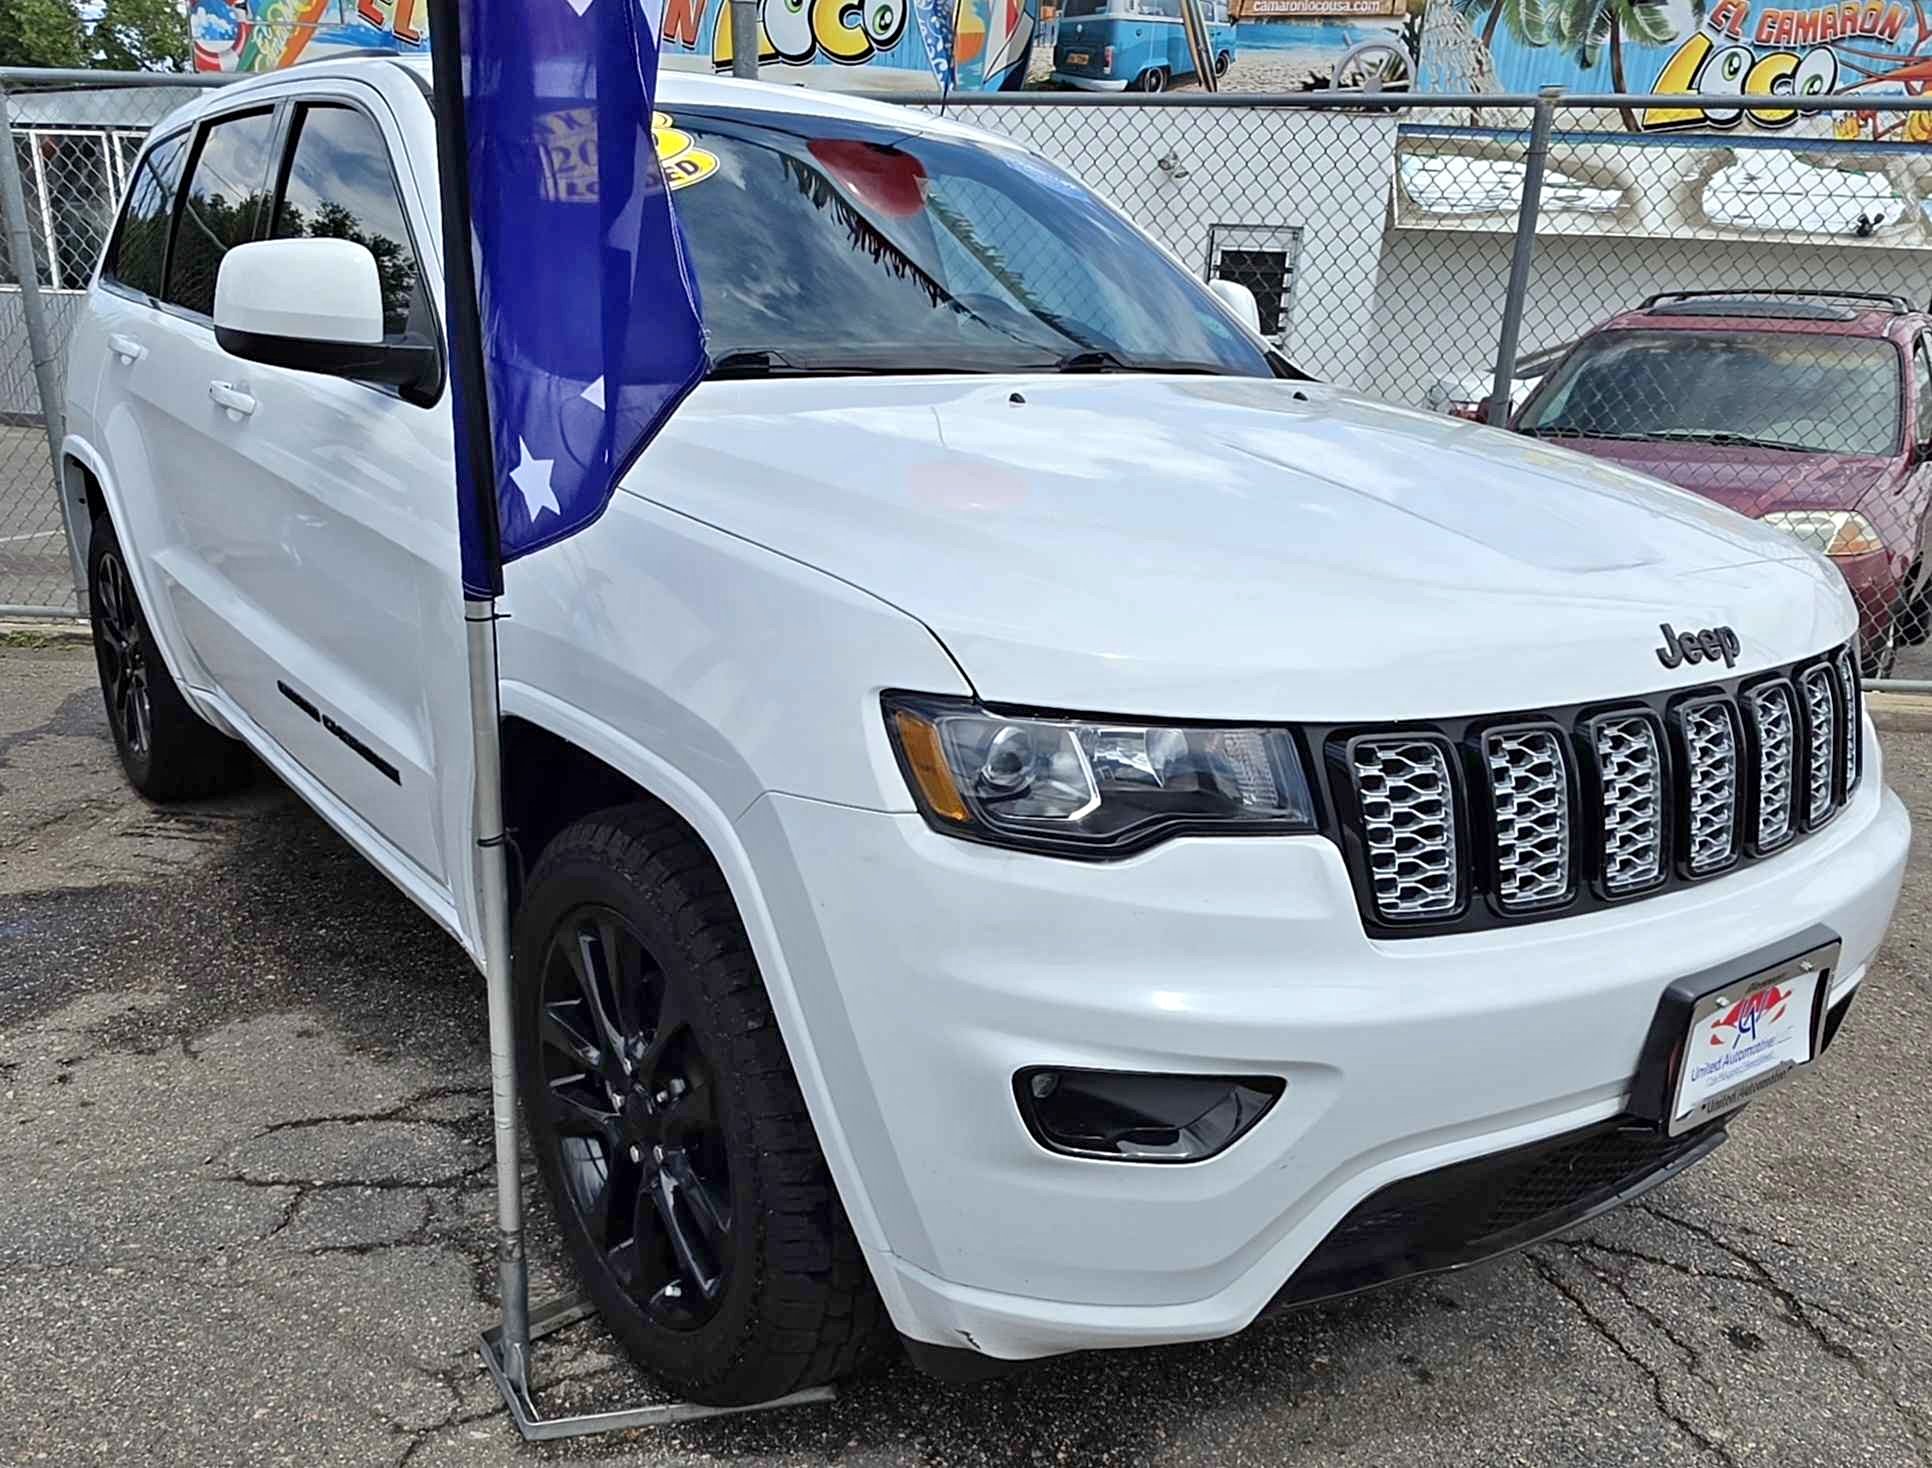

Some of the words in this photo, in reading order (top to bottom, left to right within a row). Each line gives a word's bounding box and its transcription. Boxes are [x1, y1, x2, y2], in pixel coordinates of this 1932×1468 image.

[1253, 0, 1381, 13] camaronlocousa.com
[1708, 0, 1750, 40] EL
[1754, 0, 1908, 46] CAMARON
[1641, 31, 1839, 129] LOCO
[1655, 622, 1741, 670] Jeep
[1691, 1058, 1722, 1082] United
